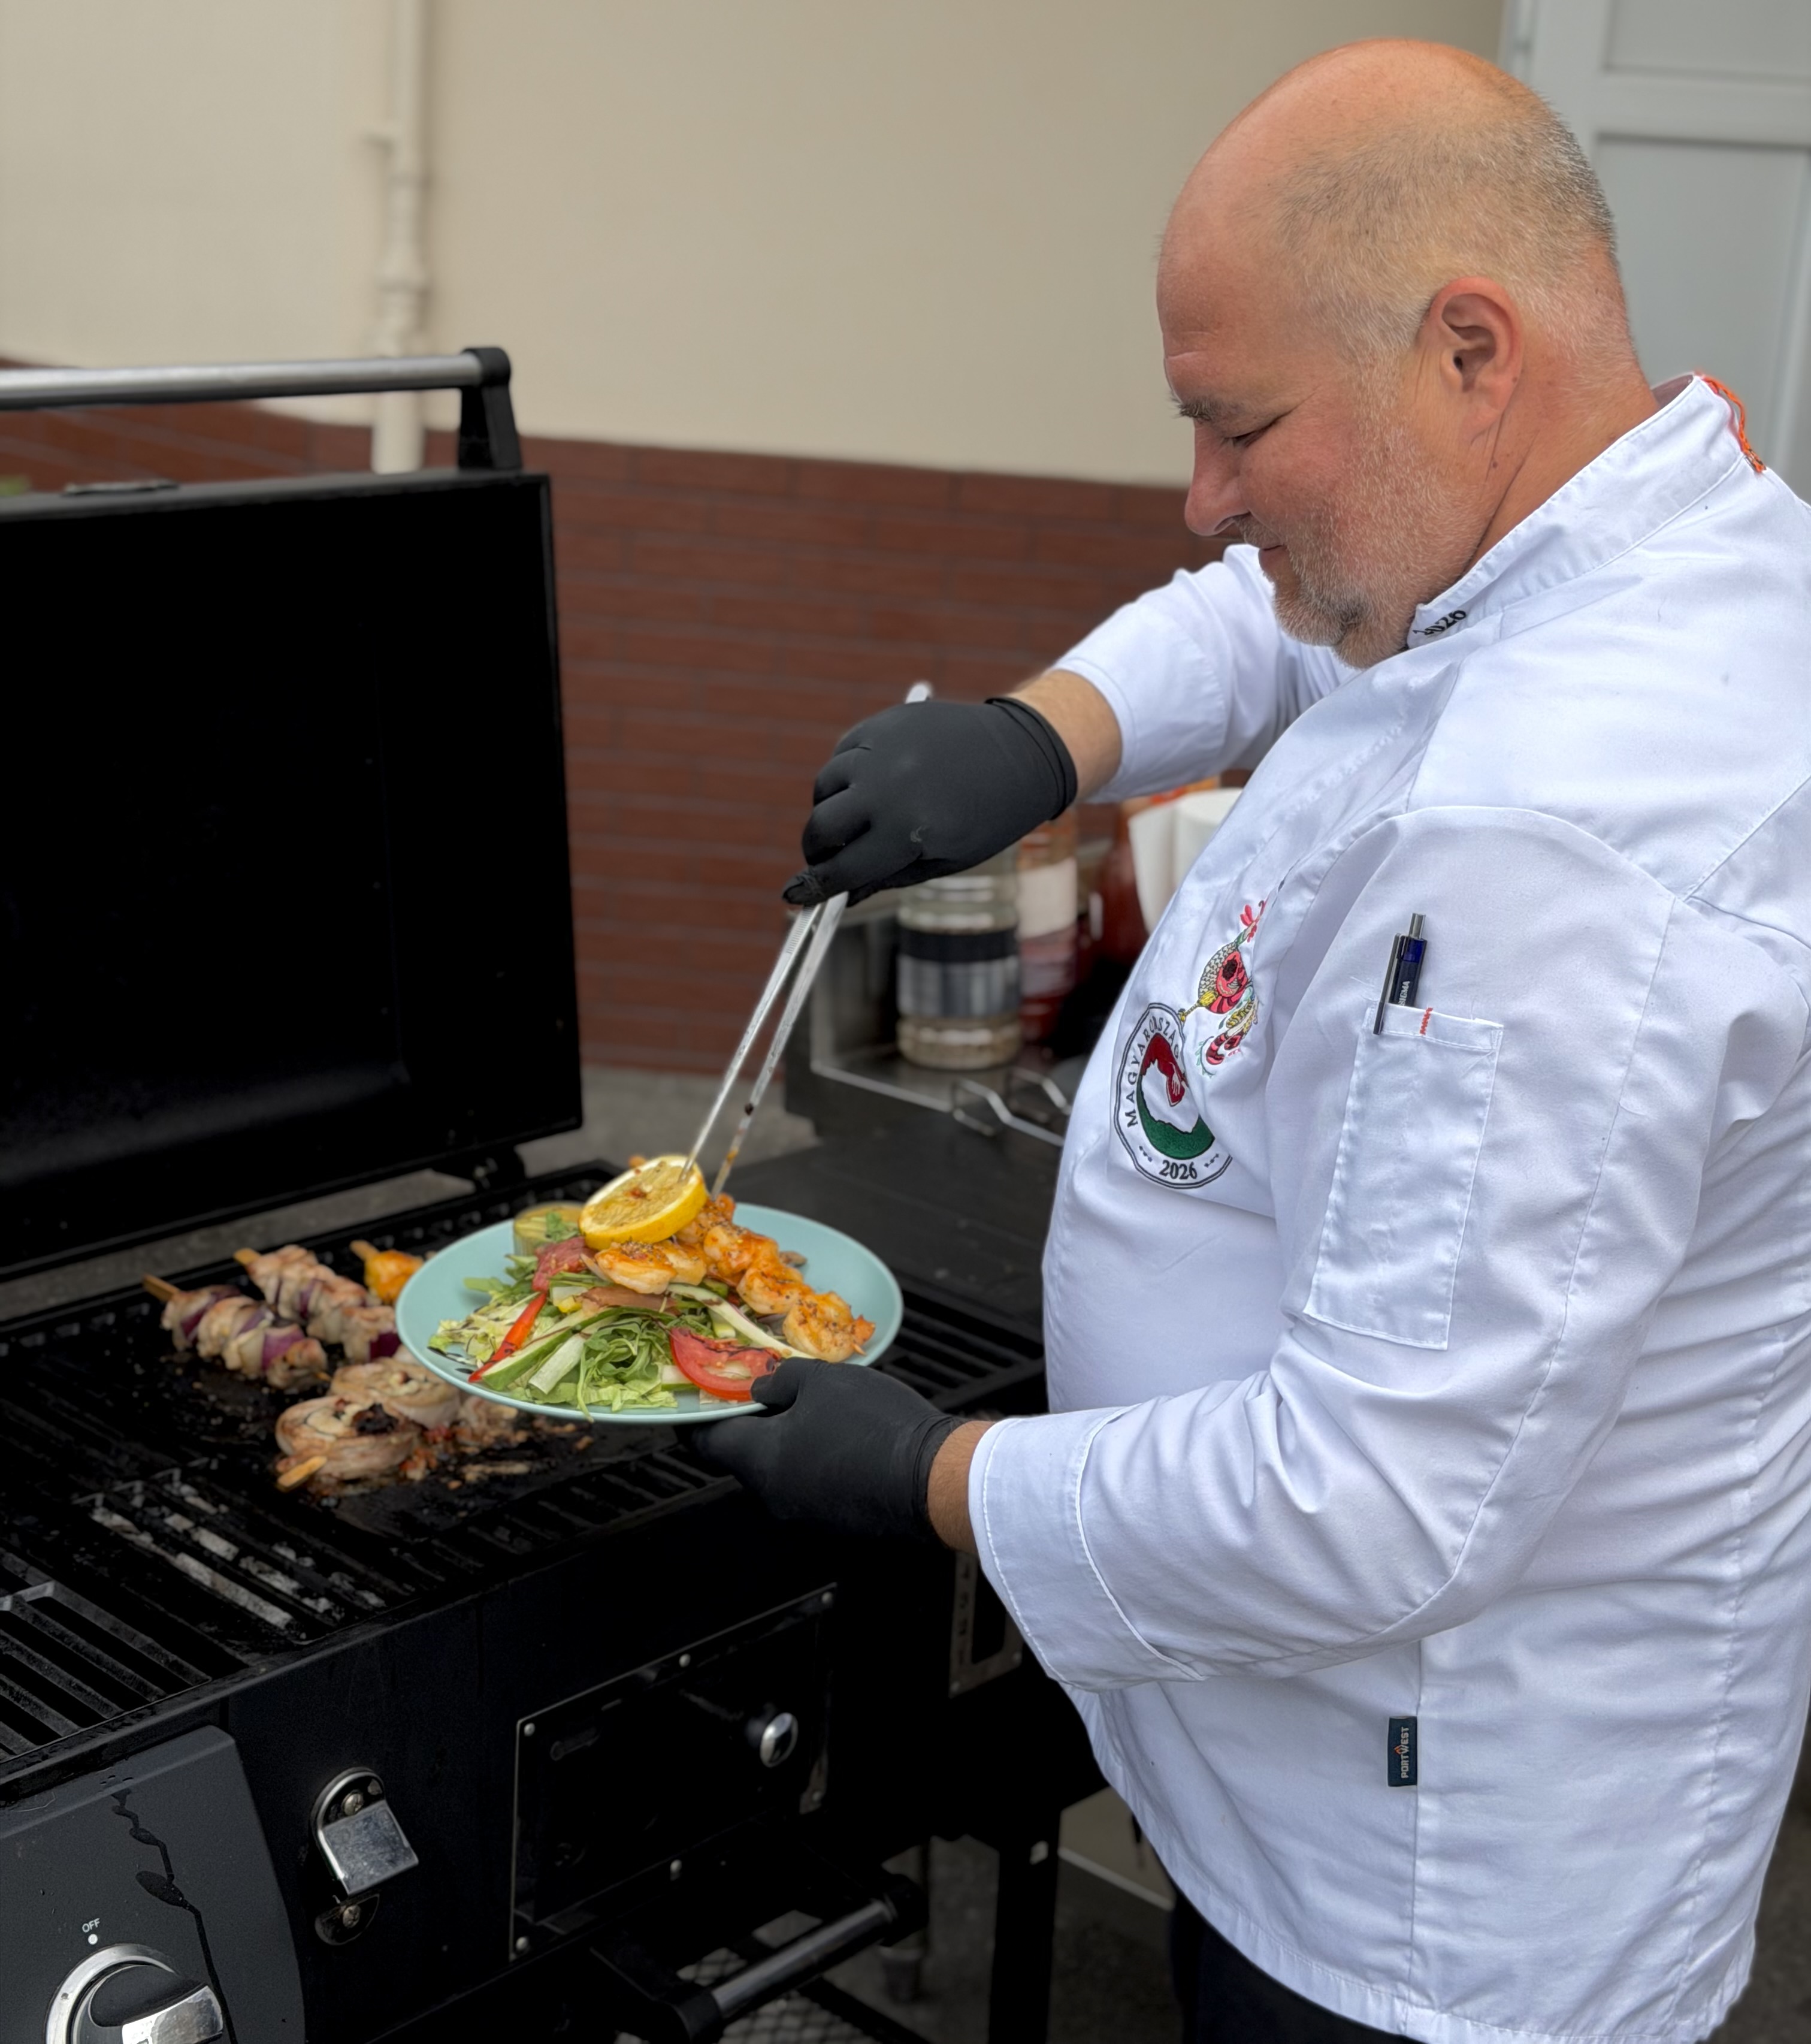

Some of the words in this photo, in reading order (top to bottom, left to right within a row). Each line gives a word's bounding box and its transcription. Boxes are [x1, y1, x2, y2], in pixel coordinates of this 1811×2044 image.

[1398, 980, 1410, 1006] SIGMA
[1159, 1160, 1198, 1179] 2026
[1394, 1726, 1409, 1779] PORTWEST
[81, 1918, 101, 1933] OFF
